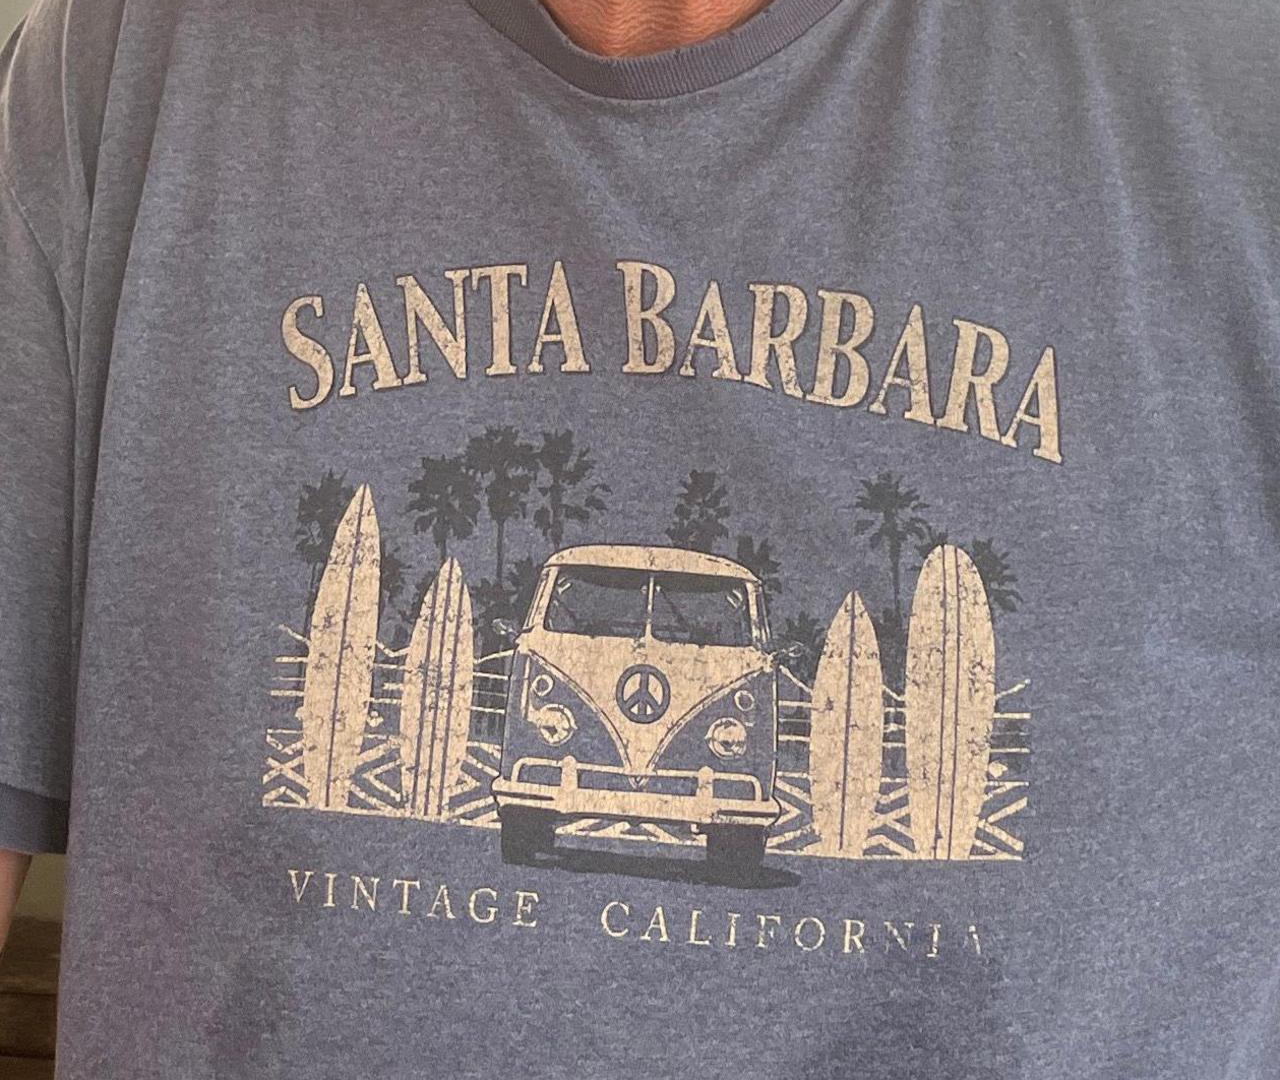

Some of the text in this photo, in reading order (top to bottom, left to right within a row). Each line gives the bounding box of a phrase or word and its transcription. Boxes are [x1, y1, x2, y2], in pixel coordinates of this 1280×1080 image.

[281, 260, 1064, 463] SANTA BARBARA
[287, 869, 540, 927] VINTAGE
